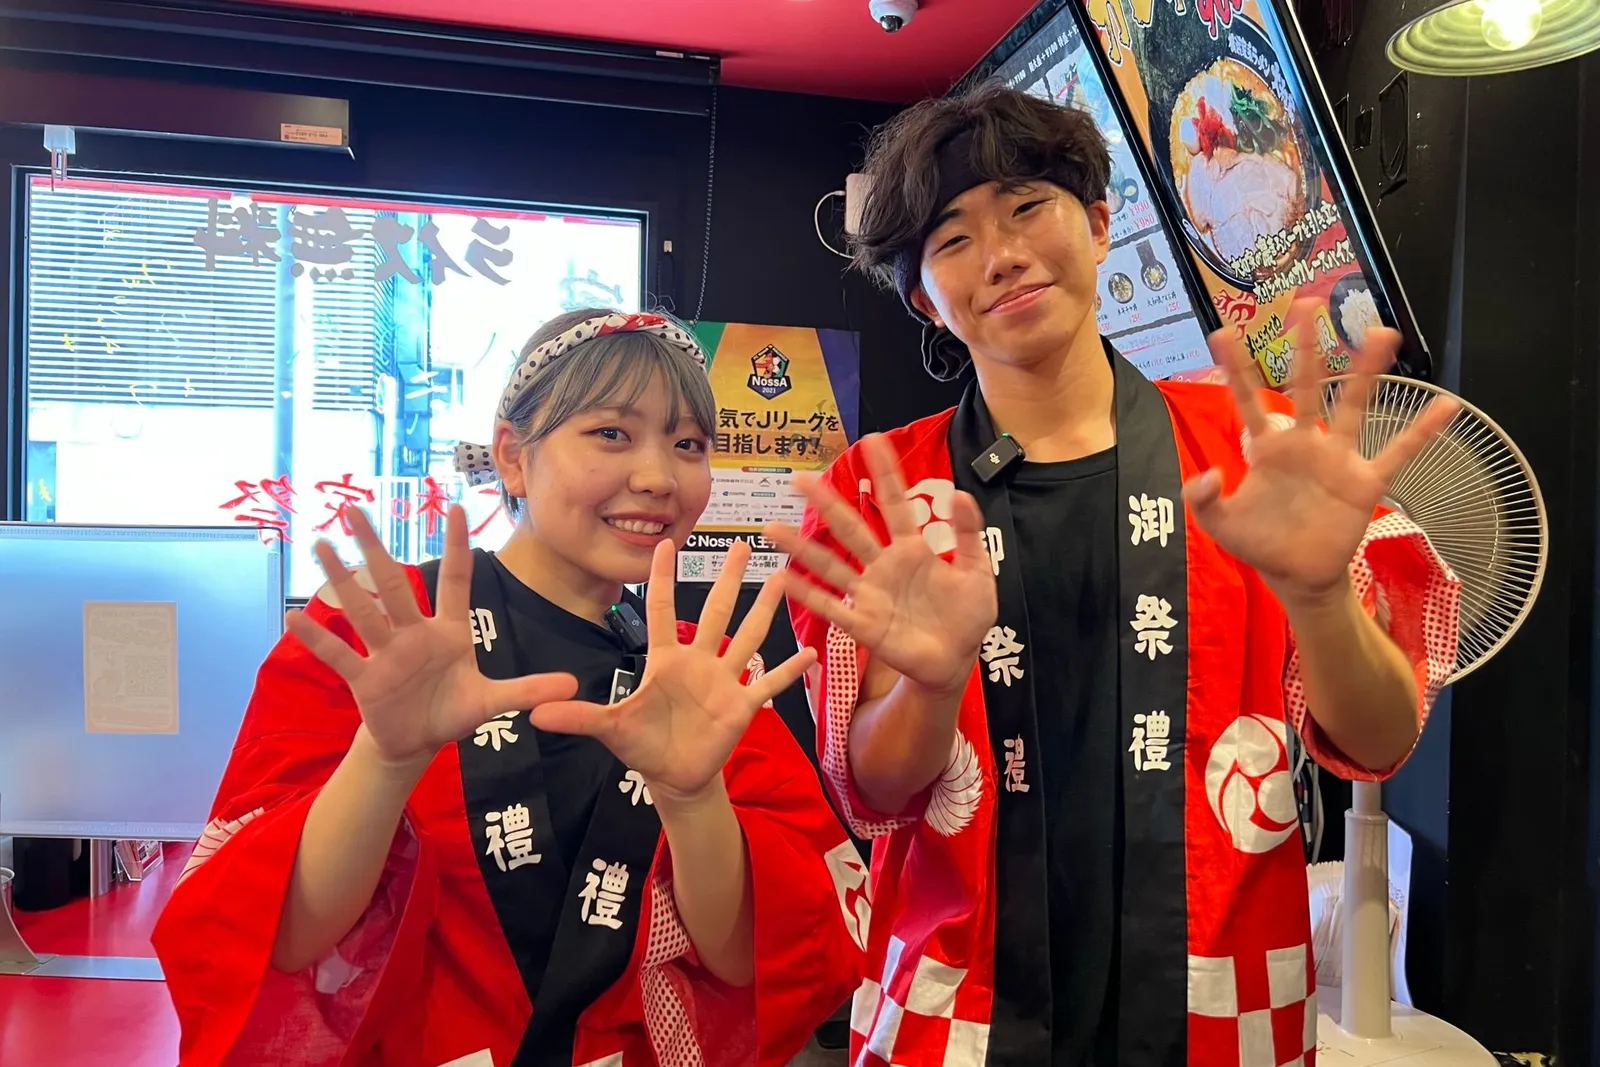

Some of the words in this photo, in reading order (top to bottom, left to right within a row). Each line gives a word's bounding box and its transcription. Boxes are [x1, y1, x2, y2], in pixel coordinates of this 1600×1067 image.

[1128, 200, 1149, 216] ¥930
[1133, 214, 1155, 231] ¥980
[752, 375, 788, 388] NossA
[1128, 493, 1178, 771] 御祭禮
